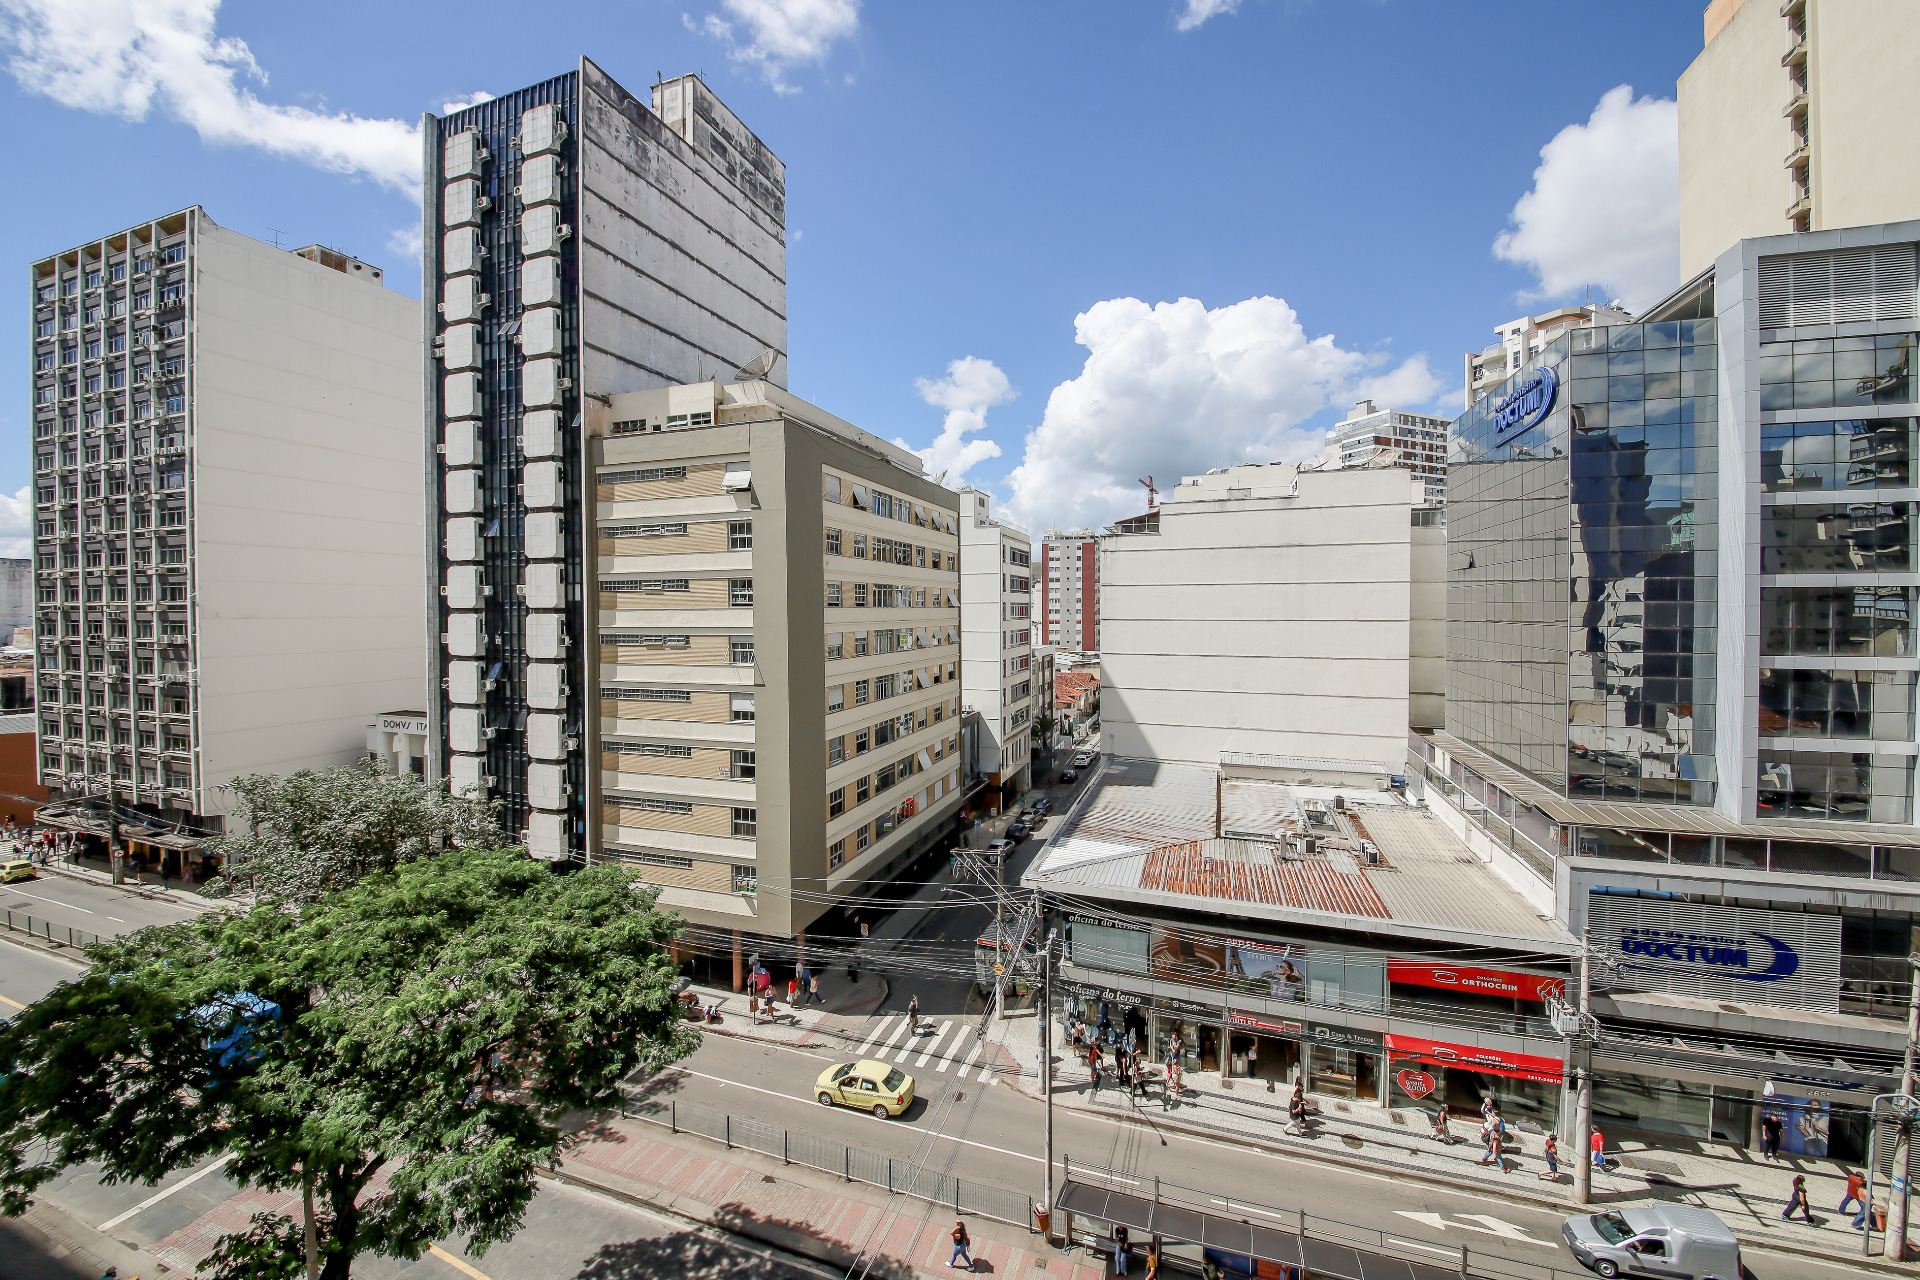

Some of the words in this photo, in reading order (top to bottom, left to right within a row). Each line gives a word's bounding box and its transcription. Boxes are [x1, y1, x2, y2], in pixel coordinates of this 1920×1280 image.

[1495, 388, 1542, 434] DOCTUM
[1068, 912, 1099, 925] oficina
[1101, 918, 1113, 928] do
[1621, 938, 1748, 968] DOCTUM
[1461, 978, 1518, 992] ORTHOCRIN
[1102, 988, 1115, 1000] do
[1115, 990, 1141, 1004] terno
[1228, 1016, 1257, 1027] OUTLET
